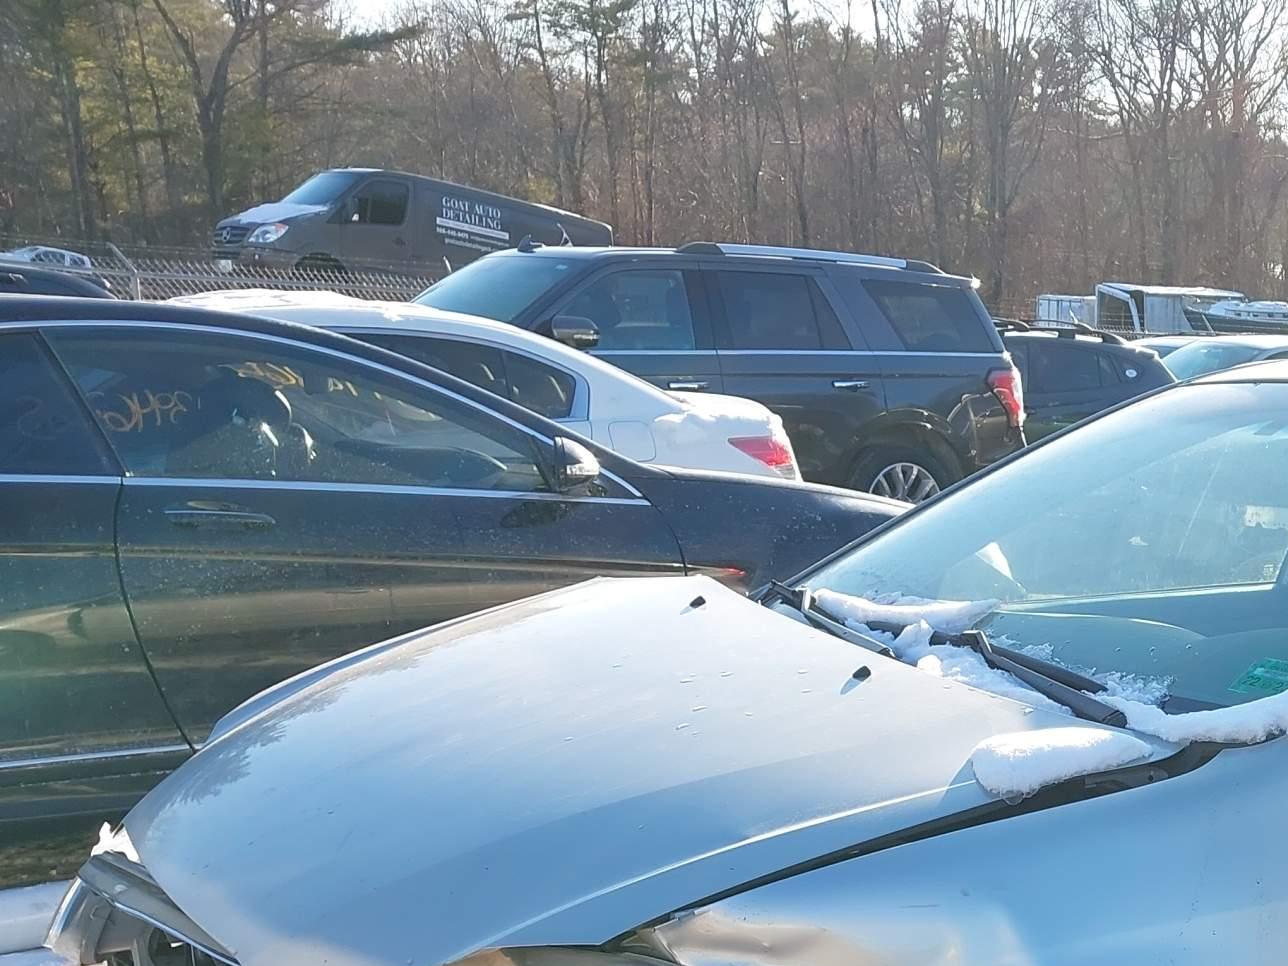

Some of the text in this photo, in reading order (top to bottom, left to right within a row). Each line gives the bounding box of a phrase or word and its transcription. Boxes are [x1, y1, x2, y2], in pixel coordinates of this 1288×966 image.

[442, 196, 501, 219] GOAT AUTO
[442, 208, 501, 230] DETAILING
